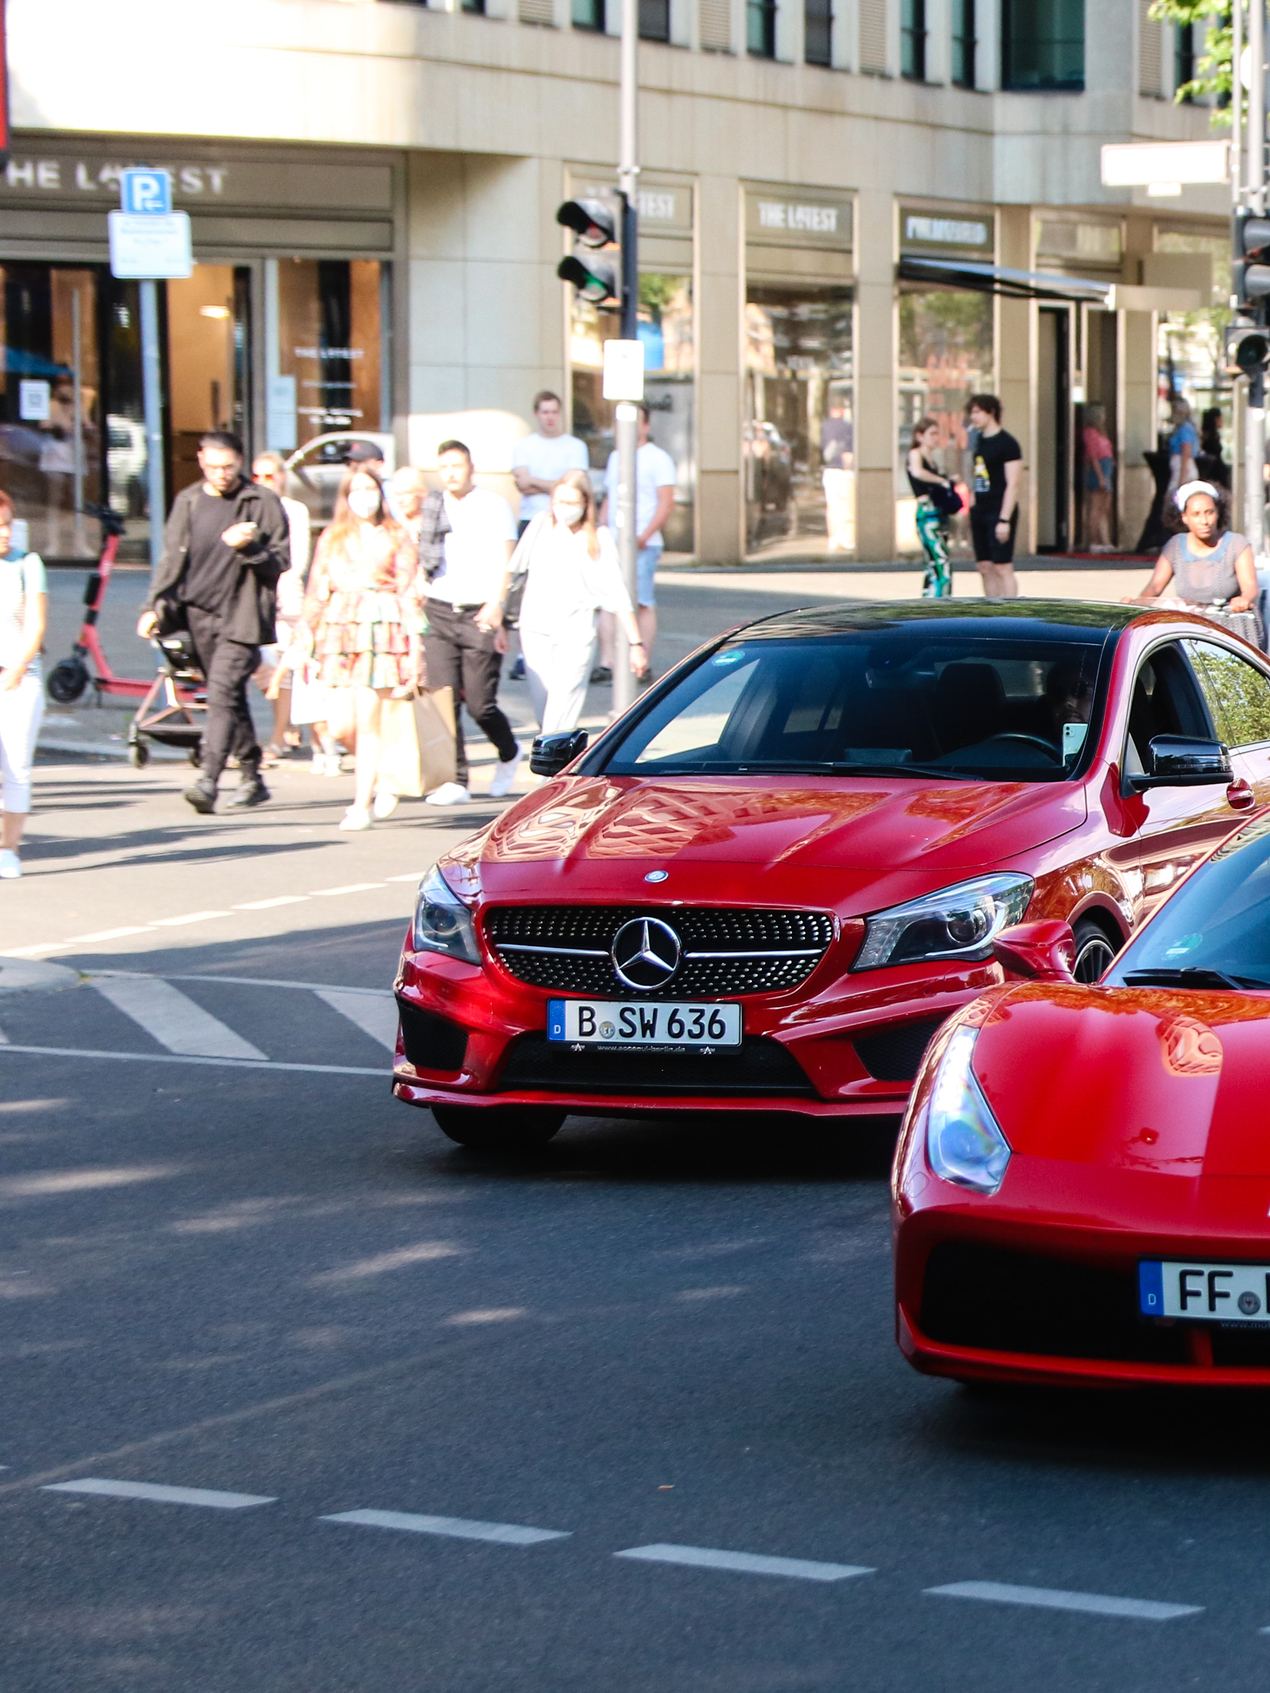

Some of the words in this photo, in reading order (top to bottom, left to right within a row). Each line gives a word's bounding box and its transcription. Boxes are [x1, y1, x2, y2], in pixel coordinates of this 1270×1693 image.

[131, 175, 160, 211] P
[758, 202, 786, 229] THE
[788, 204, 838, 233] LATEST
[553, 1025, 562, 1035] D
[578, 1006, 597, 1038] B
[618, 1006, 659, 1039] SW
[667, 1007, 727, 1040] 636
[1147, 1293, 1157, 1306] D
[1179, 1269, 1234, 1312] FF
